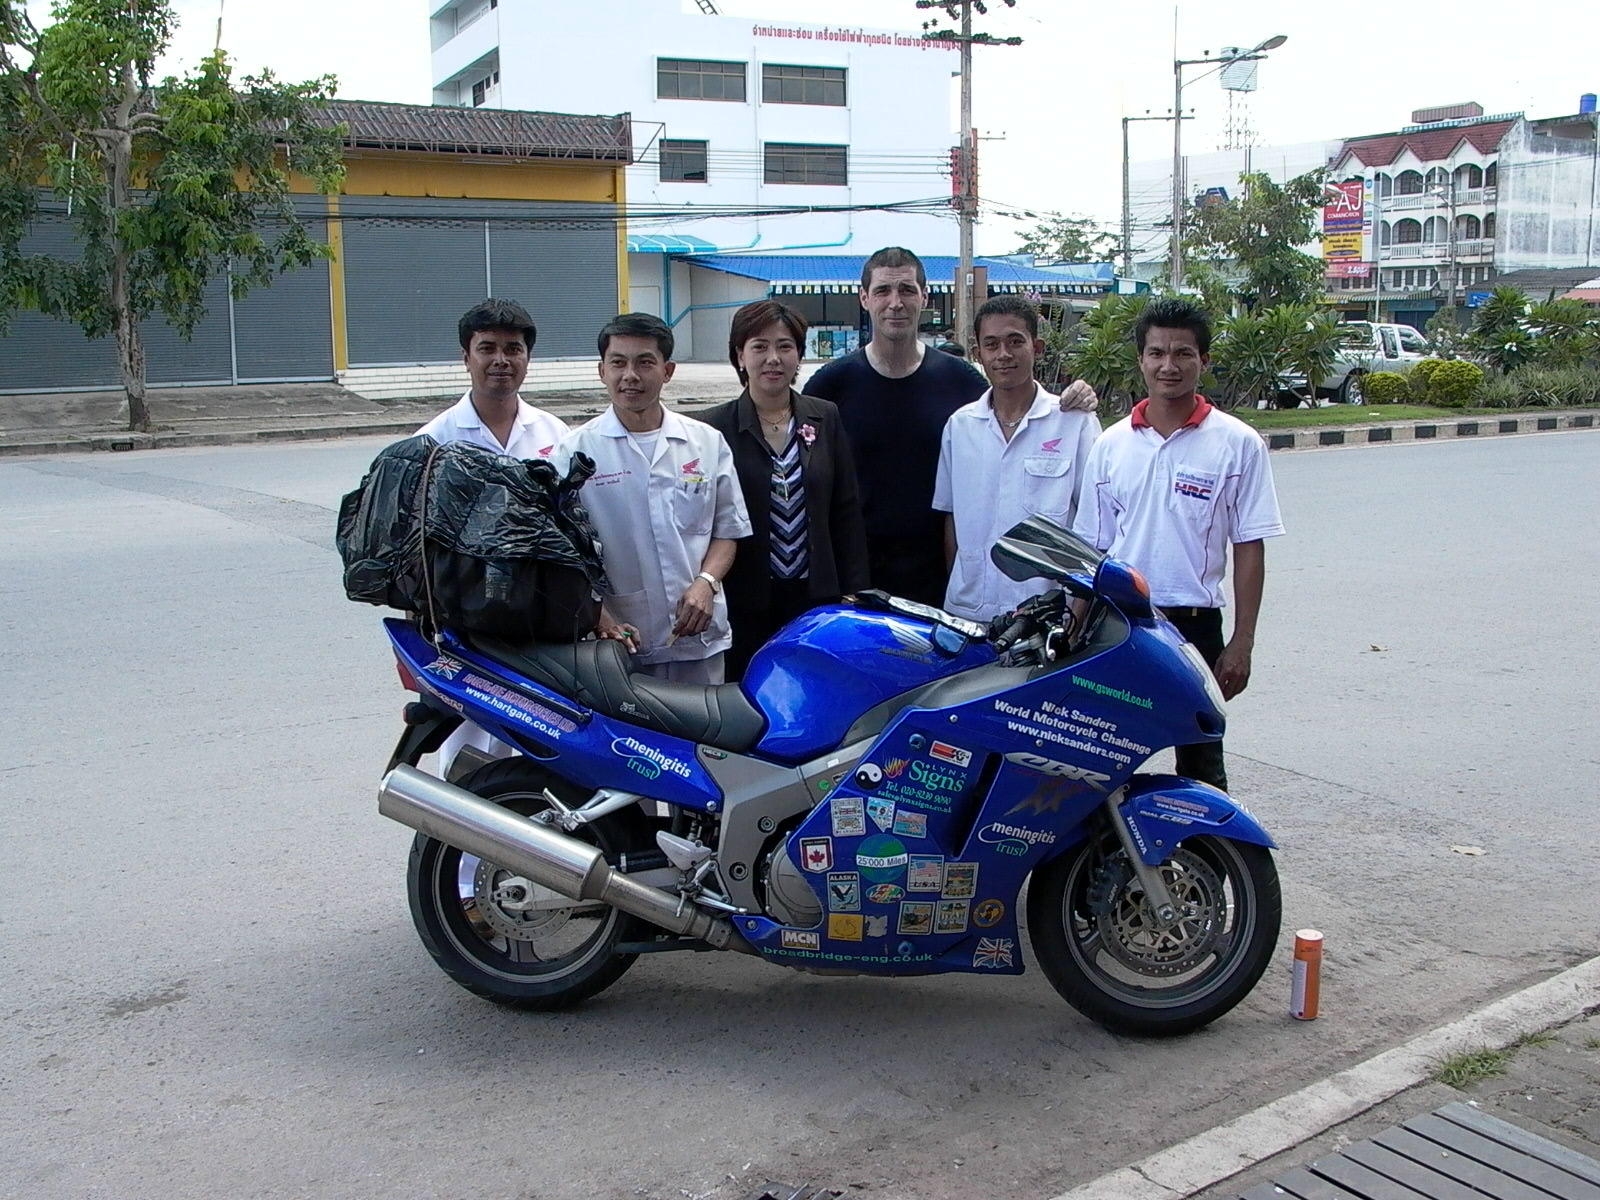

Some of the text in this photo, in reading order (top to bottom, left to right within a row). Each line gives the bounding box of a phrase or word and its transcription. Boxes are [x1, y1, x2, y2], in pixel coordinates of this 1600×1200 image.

[1336, 189, 1362, 212] AJ
[1174, 481, 1212, 501] HRC
[1072, 674, 1153, 710] www.gsworld.co.uk
[465, 686, 562, 740] www.hartgate.co.uk
[1041, 701, 1118, 732] Nick Sanders
[994, 699, 1151, 755] World Motorcycle Challenge
[1007, 720, 1131, 764] www.nicksanders.com
[625, 737, 691, 778] meningitis
[627, 757, 658, 780] trust
[909, 760, 965, 792] Signs
[992, 822, 1056, 845] meningitis
[1126, 815, 1147, 856] HONDA
[887, 856, 906, 866] Miles
[995, 842, 1025, 857] trust
[785, 931, 817, 945] MCN
[763, 946, 933, 963] broadbridge-eng.co.uk
